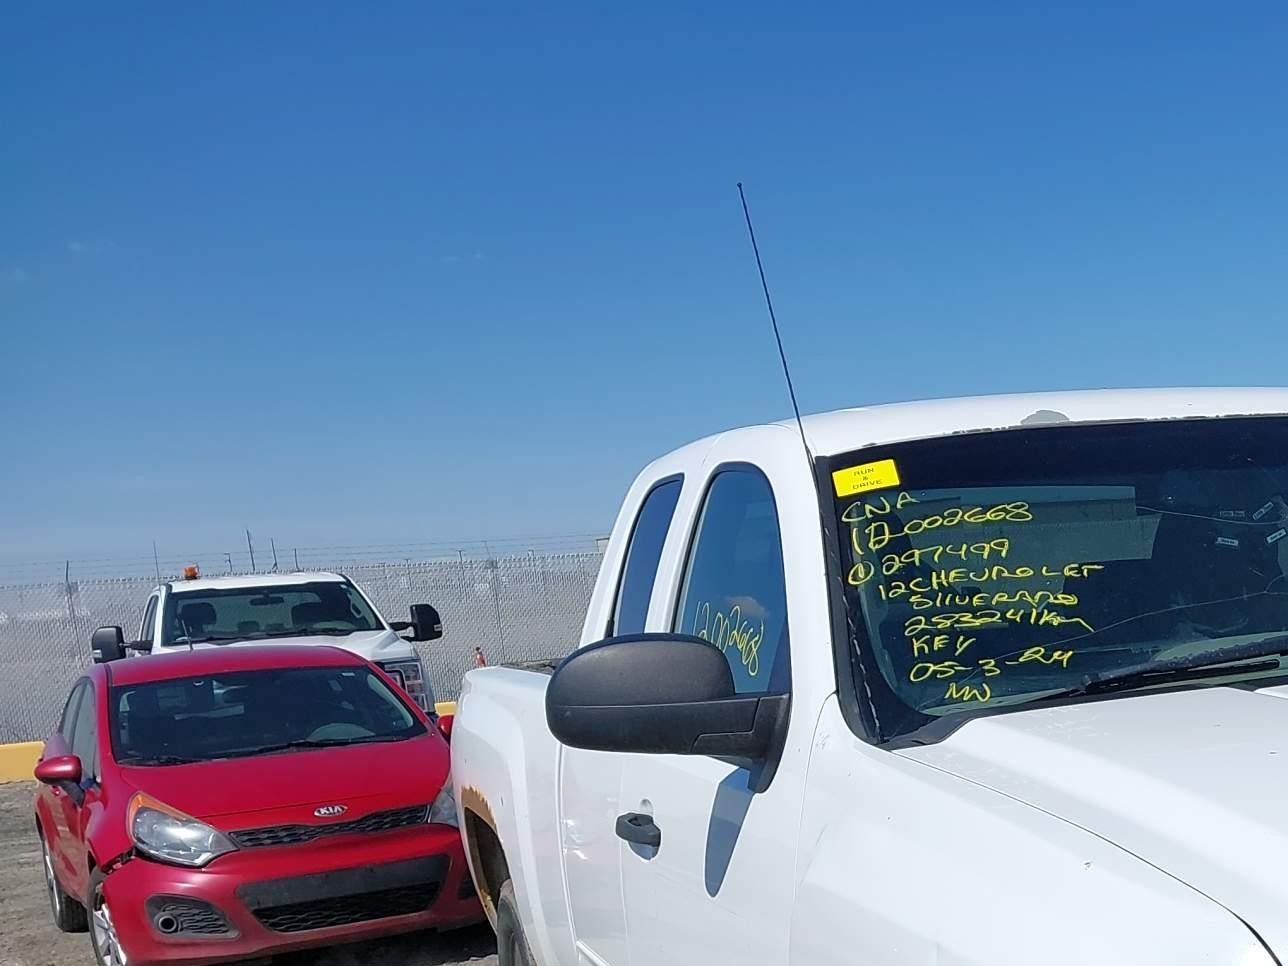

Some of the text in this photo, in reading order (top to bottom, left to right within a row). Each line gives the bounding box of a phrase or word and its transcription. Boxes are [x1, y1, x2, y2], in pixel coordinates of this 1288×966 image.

[841, 491, 921, 522] CNA
[912, 635, 977, 658] KEY
[318, 804, 344, 816] KIA
